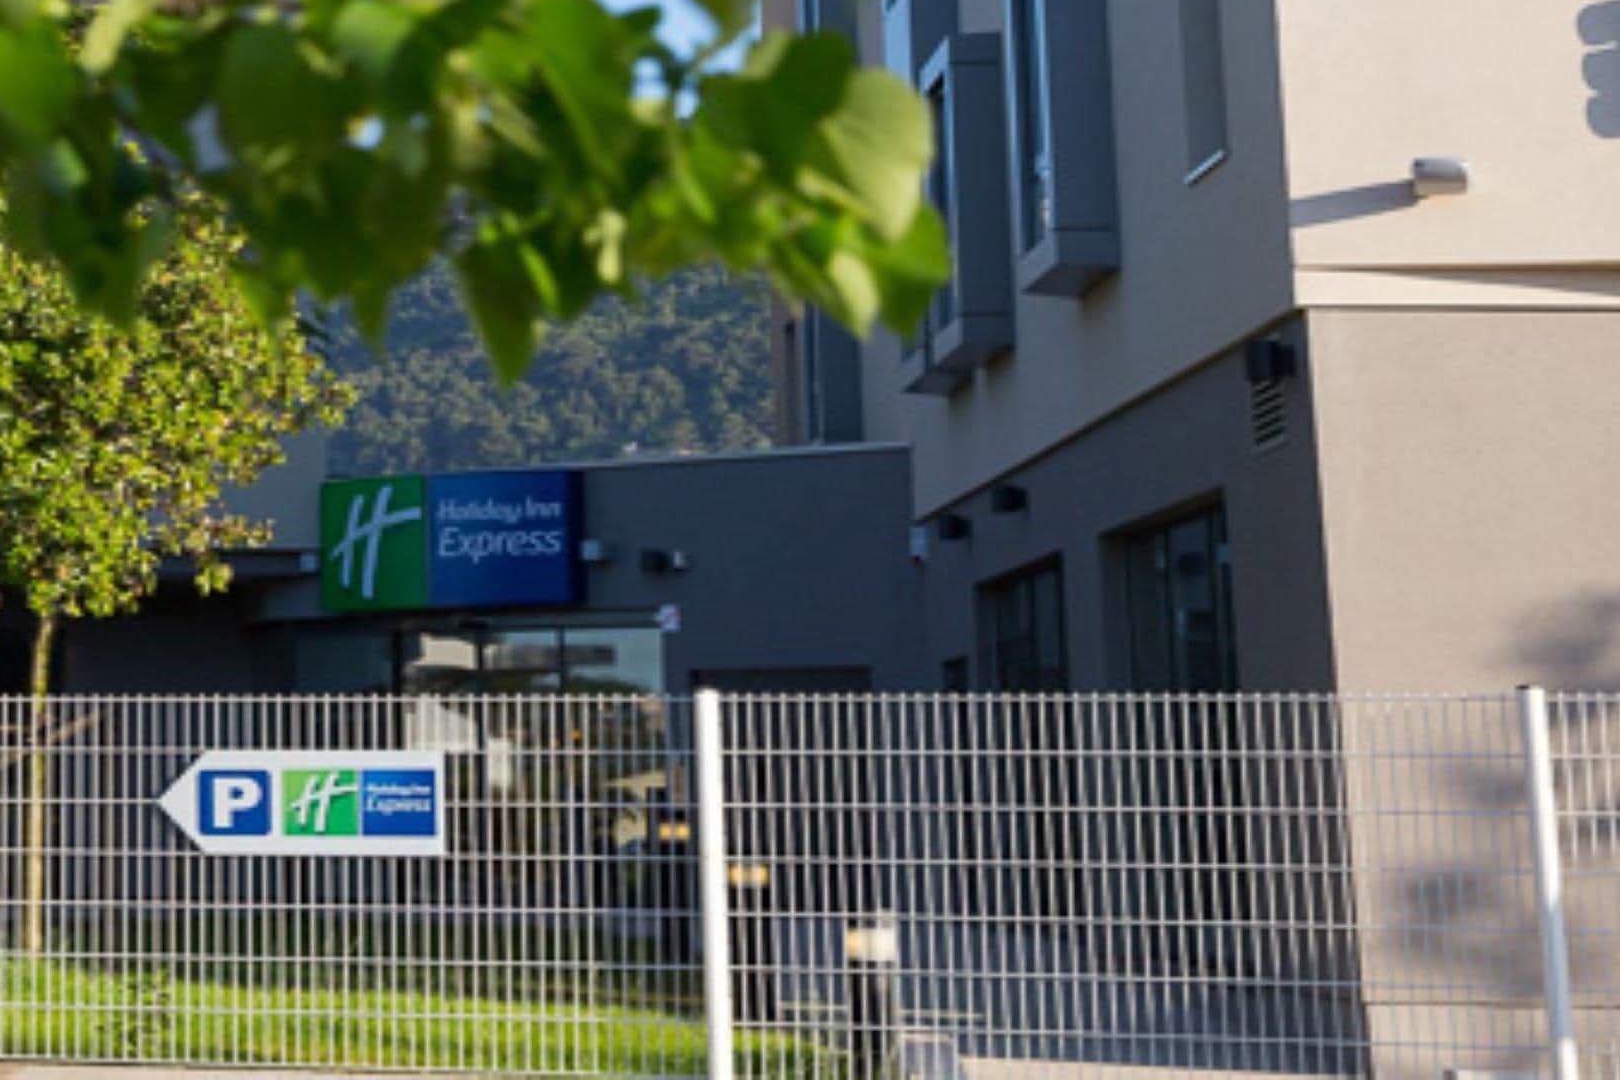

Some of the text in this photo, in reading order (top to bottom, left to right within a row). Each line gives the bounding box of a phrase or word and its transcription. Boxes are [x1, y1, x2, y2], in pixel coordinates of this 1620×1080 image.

[437, 495, 561, 524] Holiday Inn
[438, 526, 561, 564] Express
[212, 777, 262, 829] P
